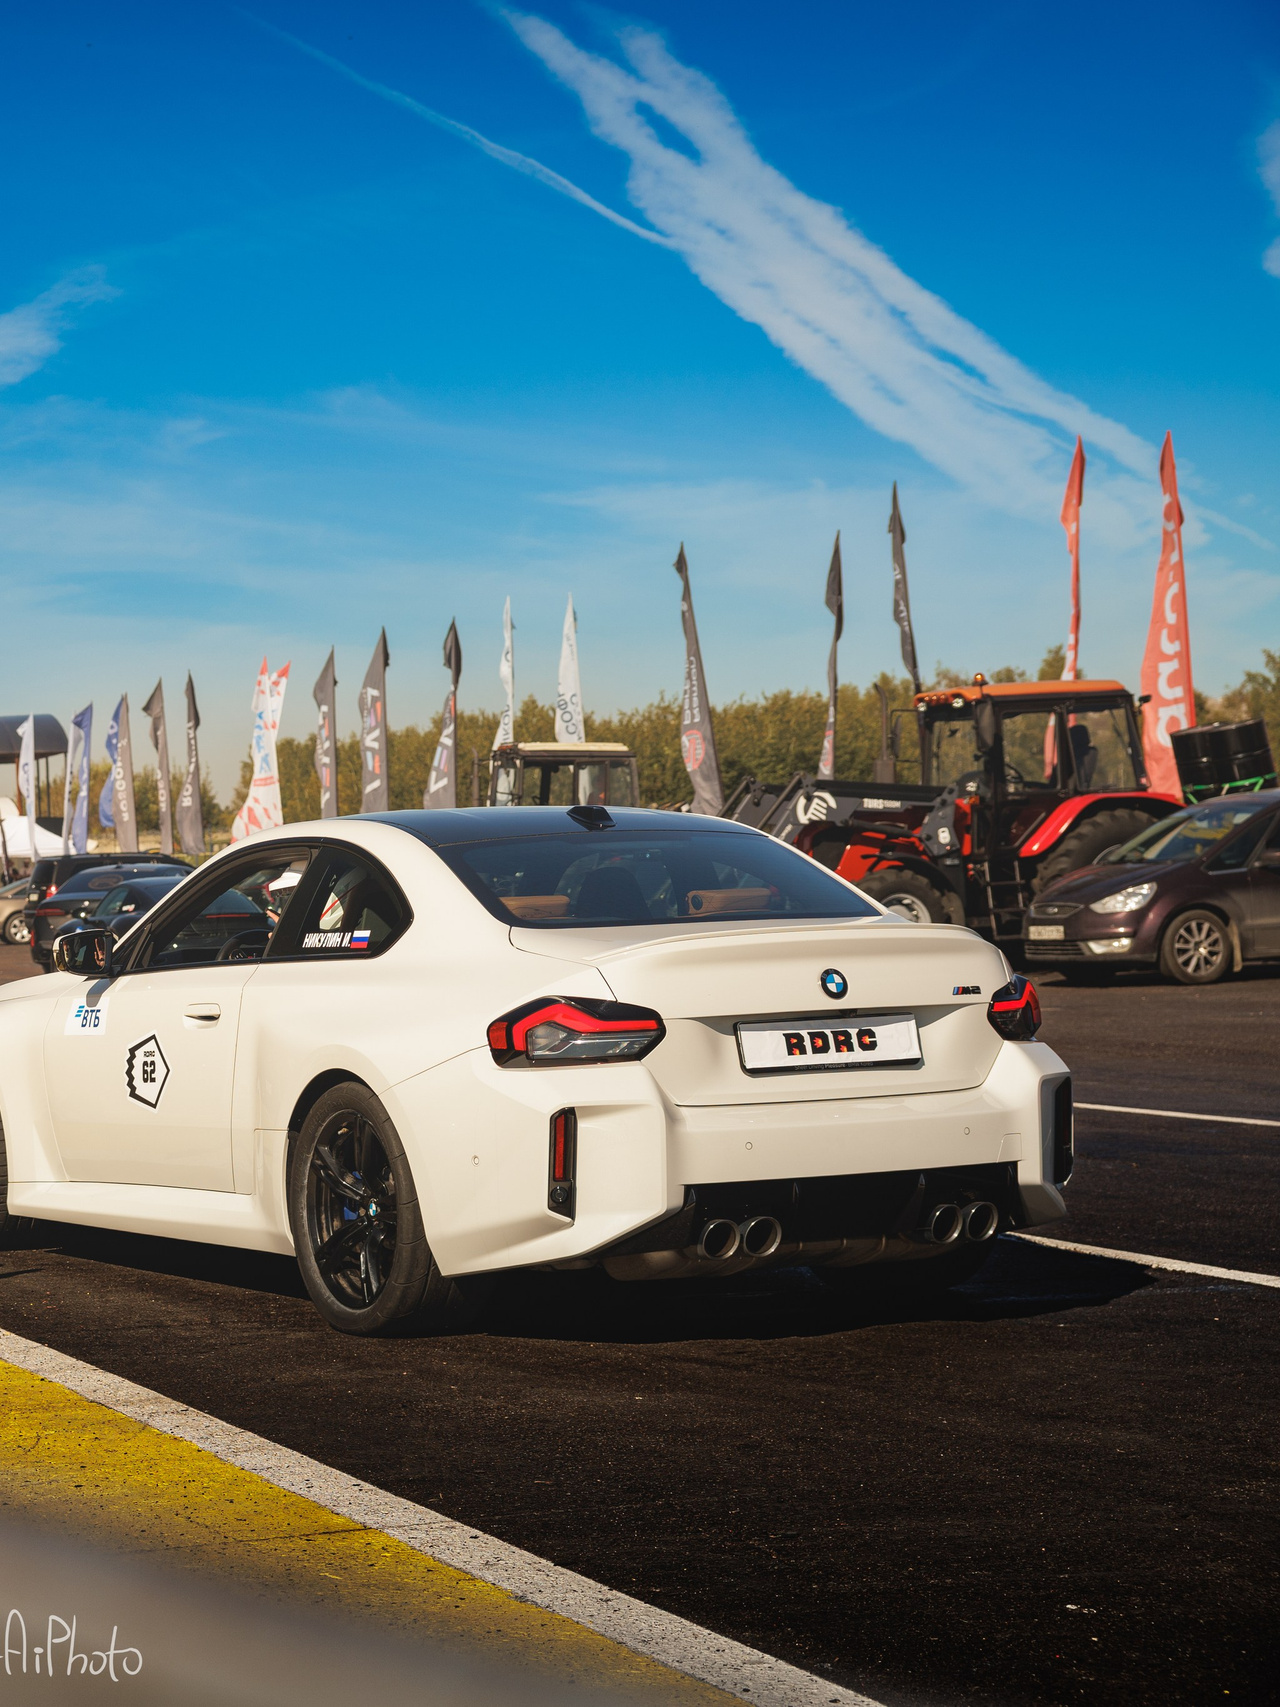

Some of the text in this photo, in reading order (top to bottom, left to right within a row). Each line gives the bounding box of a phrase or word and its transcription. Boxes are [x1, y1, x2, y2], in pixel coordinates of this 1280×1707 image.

[302, 932, 352, 948] НИКУЛИН И.
[959, 985, 982, 995] M2
[81, 1009, 101, 1028] ВТБ
[782, 1028, 878, 1056] RDRC
[142, 1060, 156, 1083] 62
